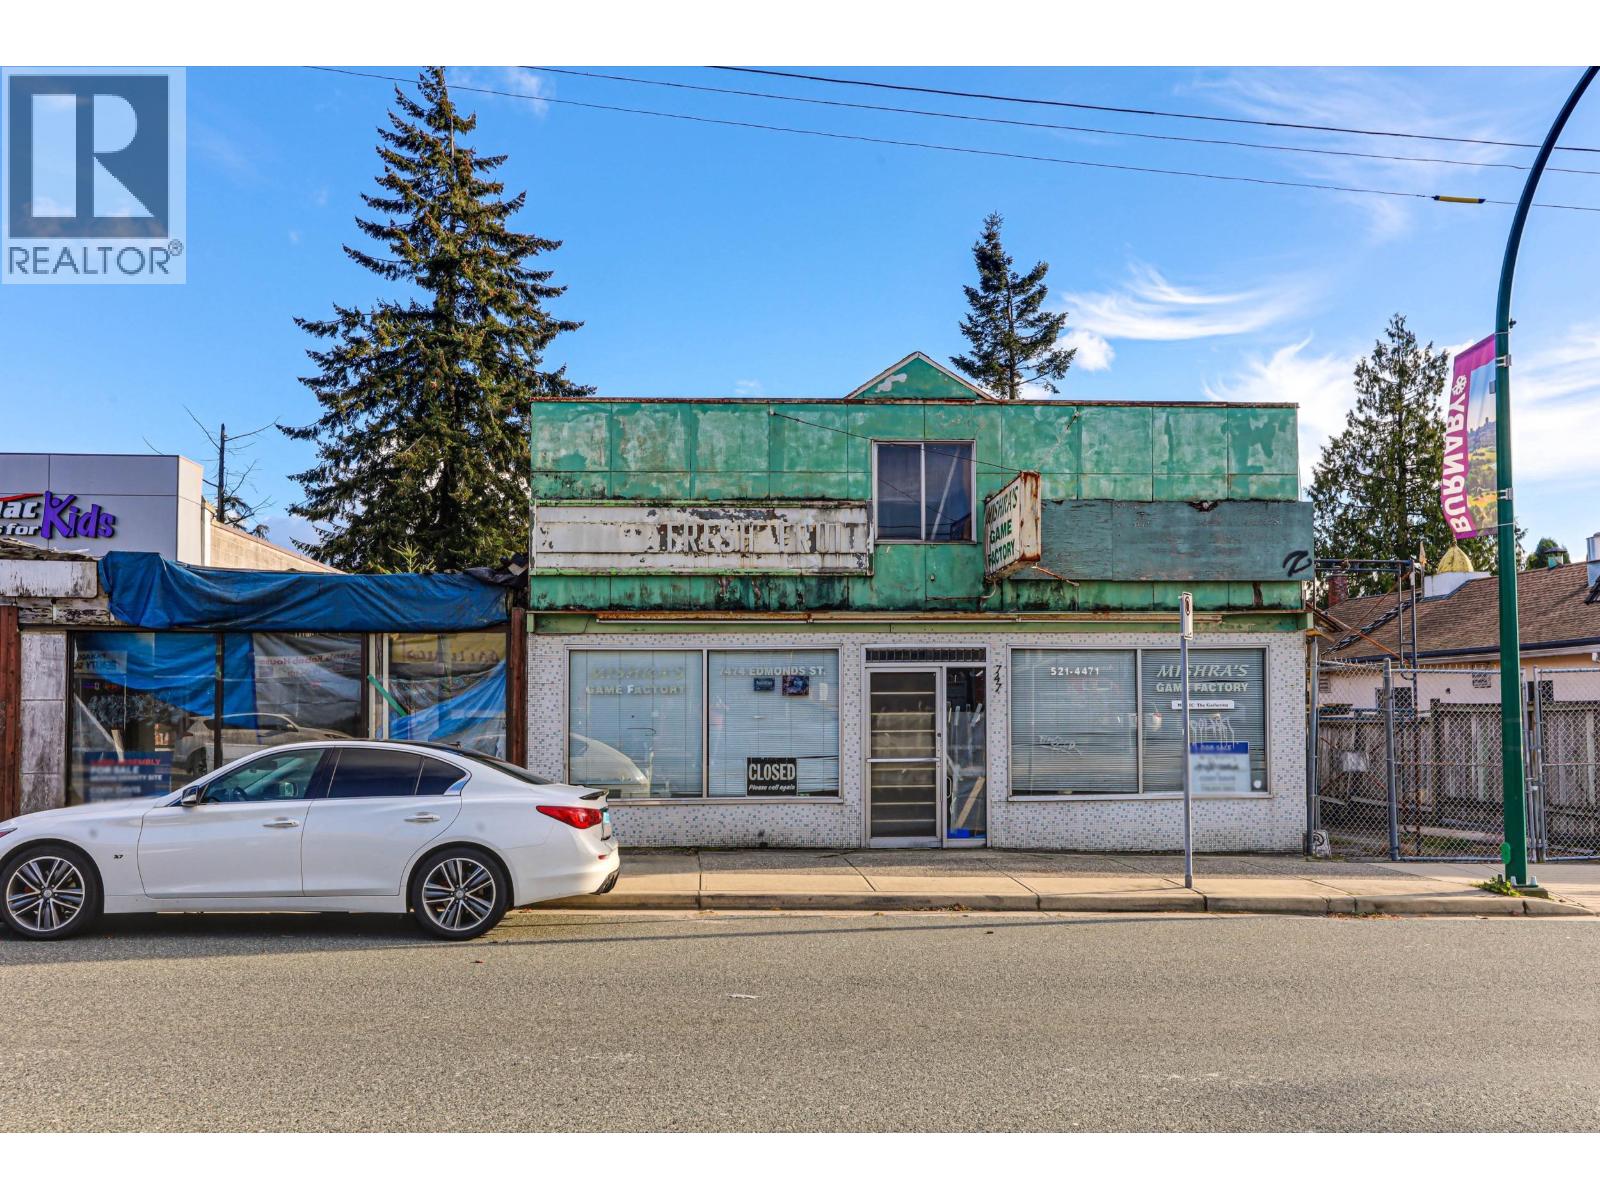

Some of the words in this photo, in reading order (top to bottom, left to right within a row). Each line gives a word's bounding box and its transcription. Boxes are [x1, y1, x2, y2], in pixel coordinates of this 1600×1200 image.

[41, 490, 116, 539] Kids
[6, 523, 39, 535] for
[989, 519, 1012, 544] GAME
[988, 539, 1015, 568] FACTORY
[749, 666, 806, 676] EDMONDS
[1157, 683, 1190, 692] GAM
[1194, 683, 1248, 692] FACTORY
[749, 763, 796, 781] CLOSED
